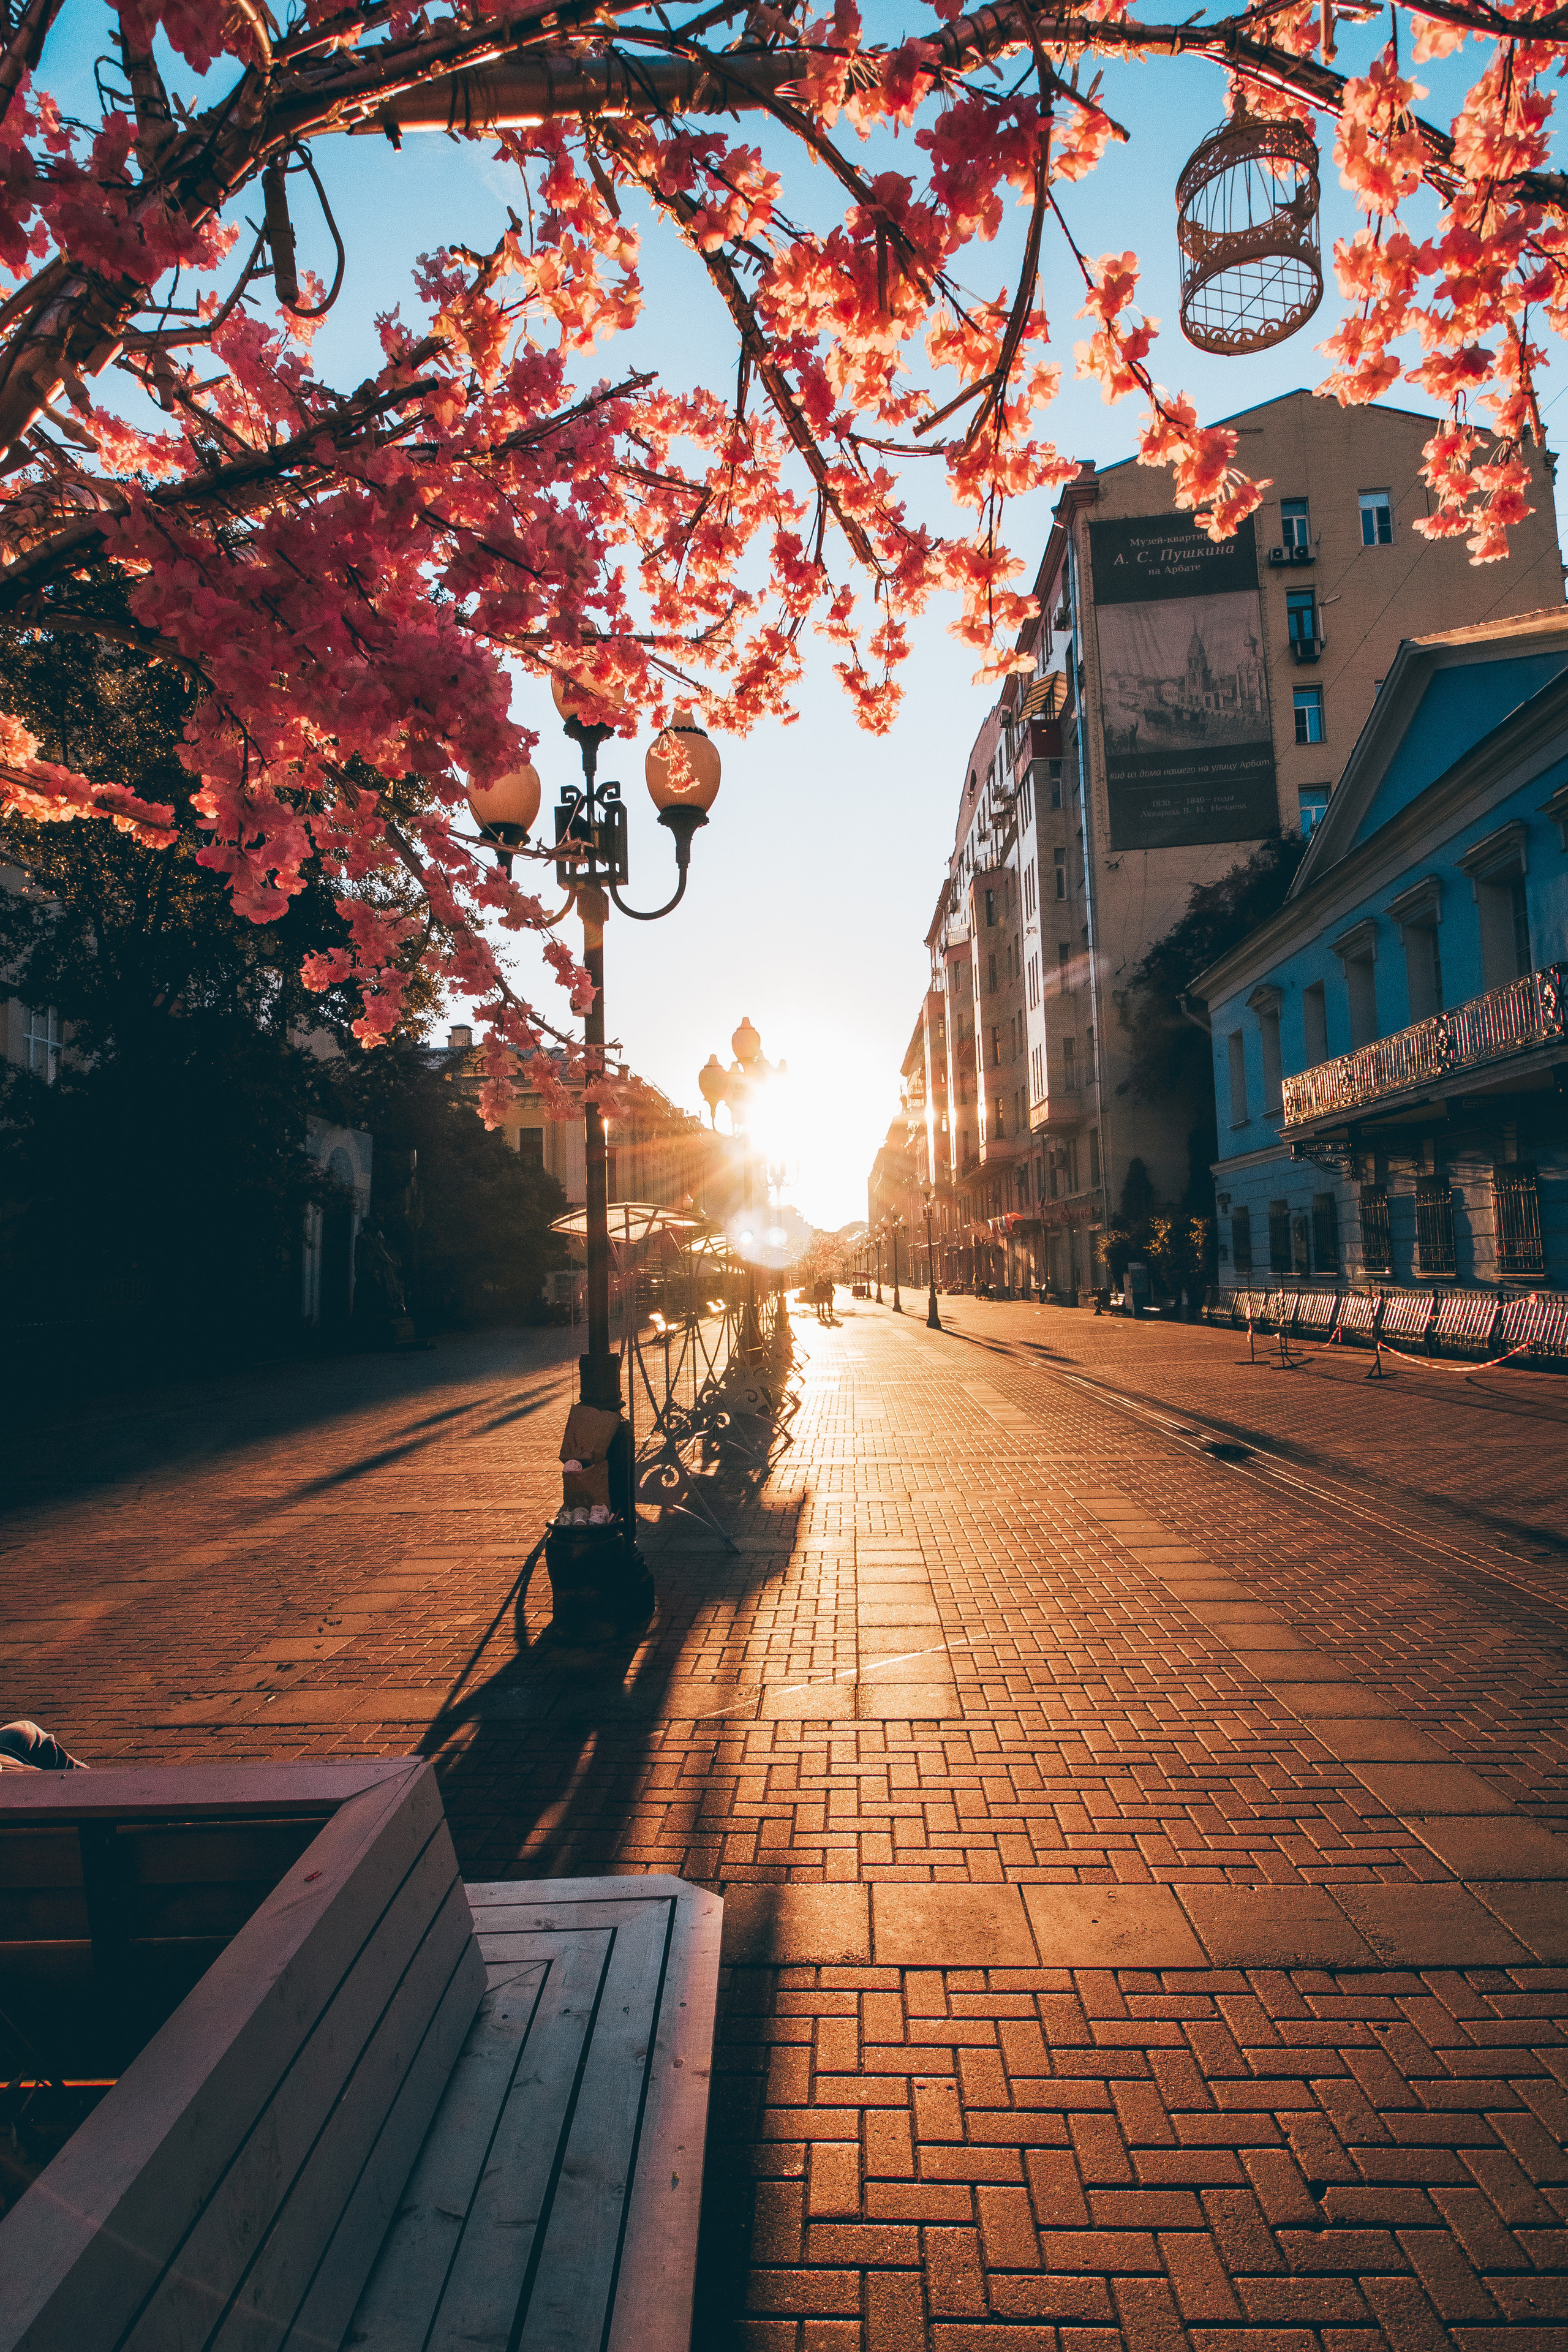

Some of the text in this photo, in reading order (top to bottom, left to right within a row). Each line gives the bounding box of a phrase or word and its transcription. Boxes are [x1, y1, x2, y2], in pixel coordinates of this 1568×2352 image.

[1130, 532, 1208, 548] Музей-квартир
[1114, 545, 1235, 565] А. С. Пушкина
[1164, 564, 1201, 575] Арбате
[1164, 767, 1196, 775] нашего
[1212, 763, 1237, 773] улицу
[1240, 760, 1272, 769] Арбат.
[1140, 809, 1181, 818] Акварель
